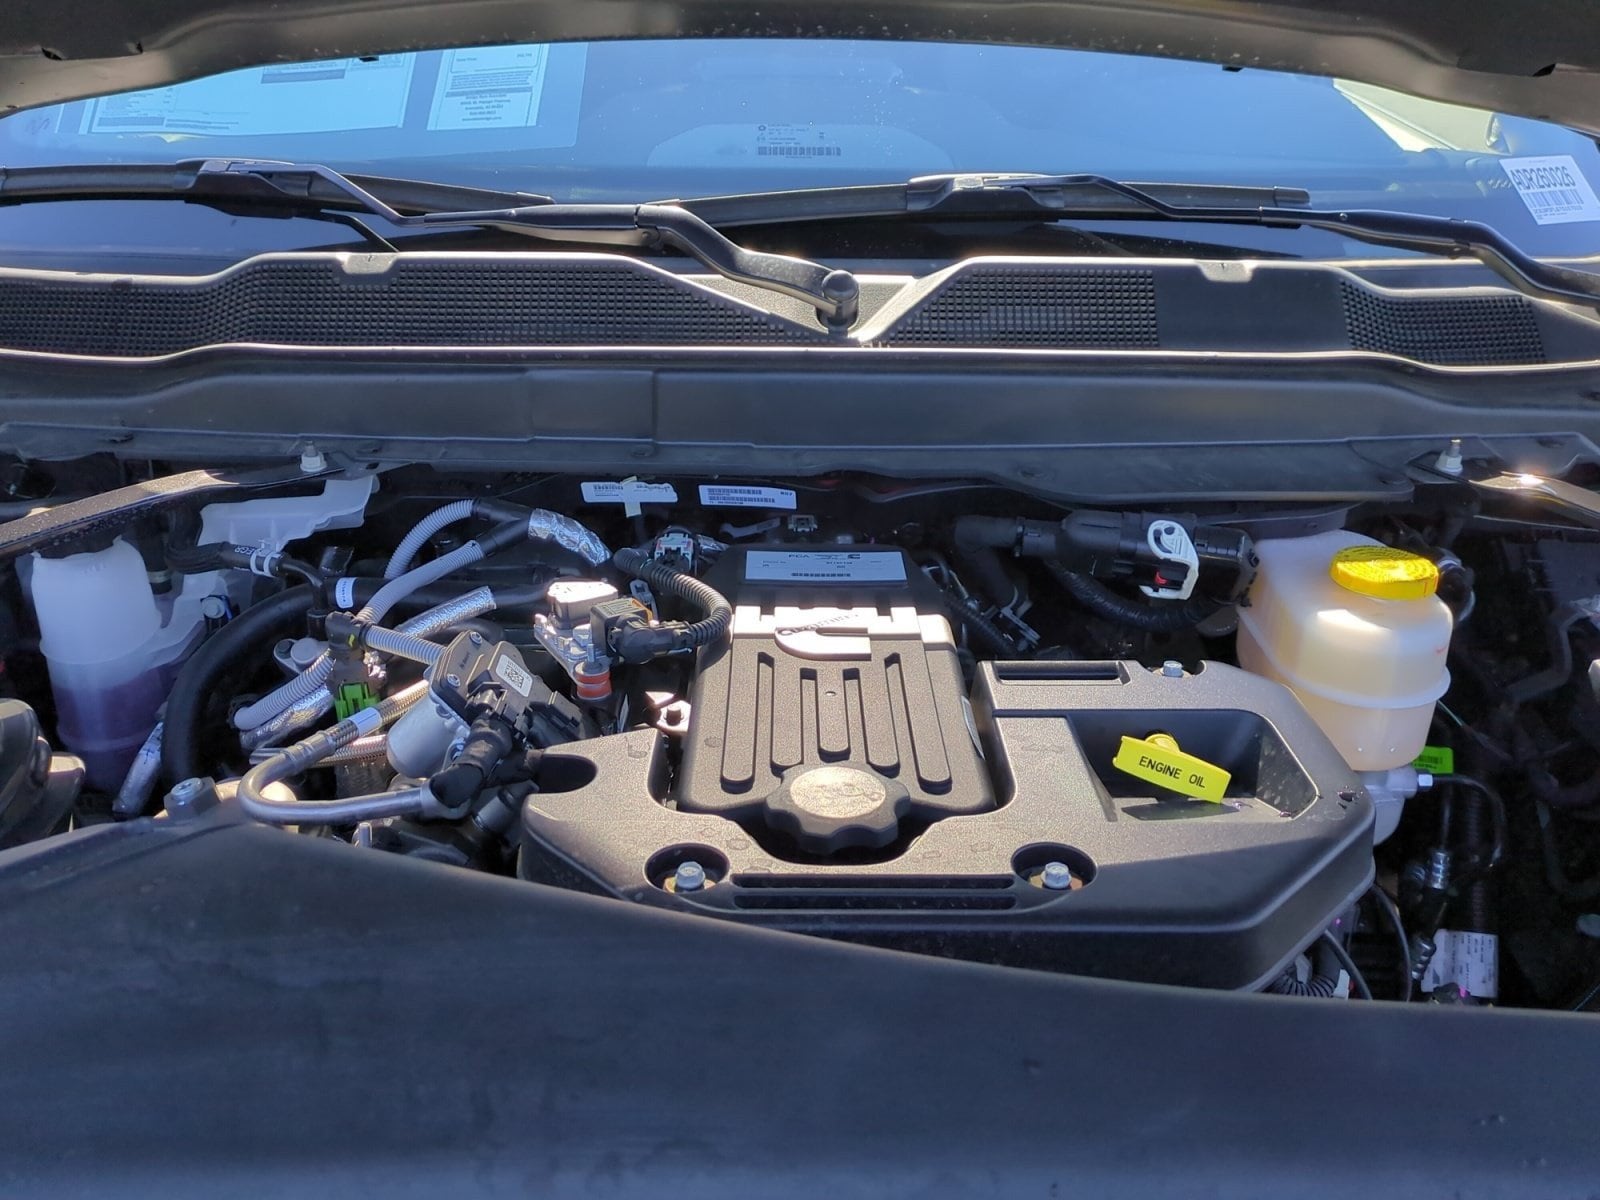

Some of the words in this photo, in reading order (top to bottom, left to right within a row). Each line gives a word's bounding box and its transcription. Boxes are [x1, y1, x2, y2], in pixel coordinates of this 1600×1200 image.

[1510, 166, 1576, 190] ADR260026
[1138, 755, 1182, 779] ENGINE
[1188, 774, 1205, 788] OIL
